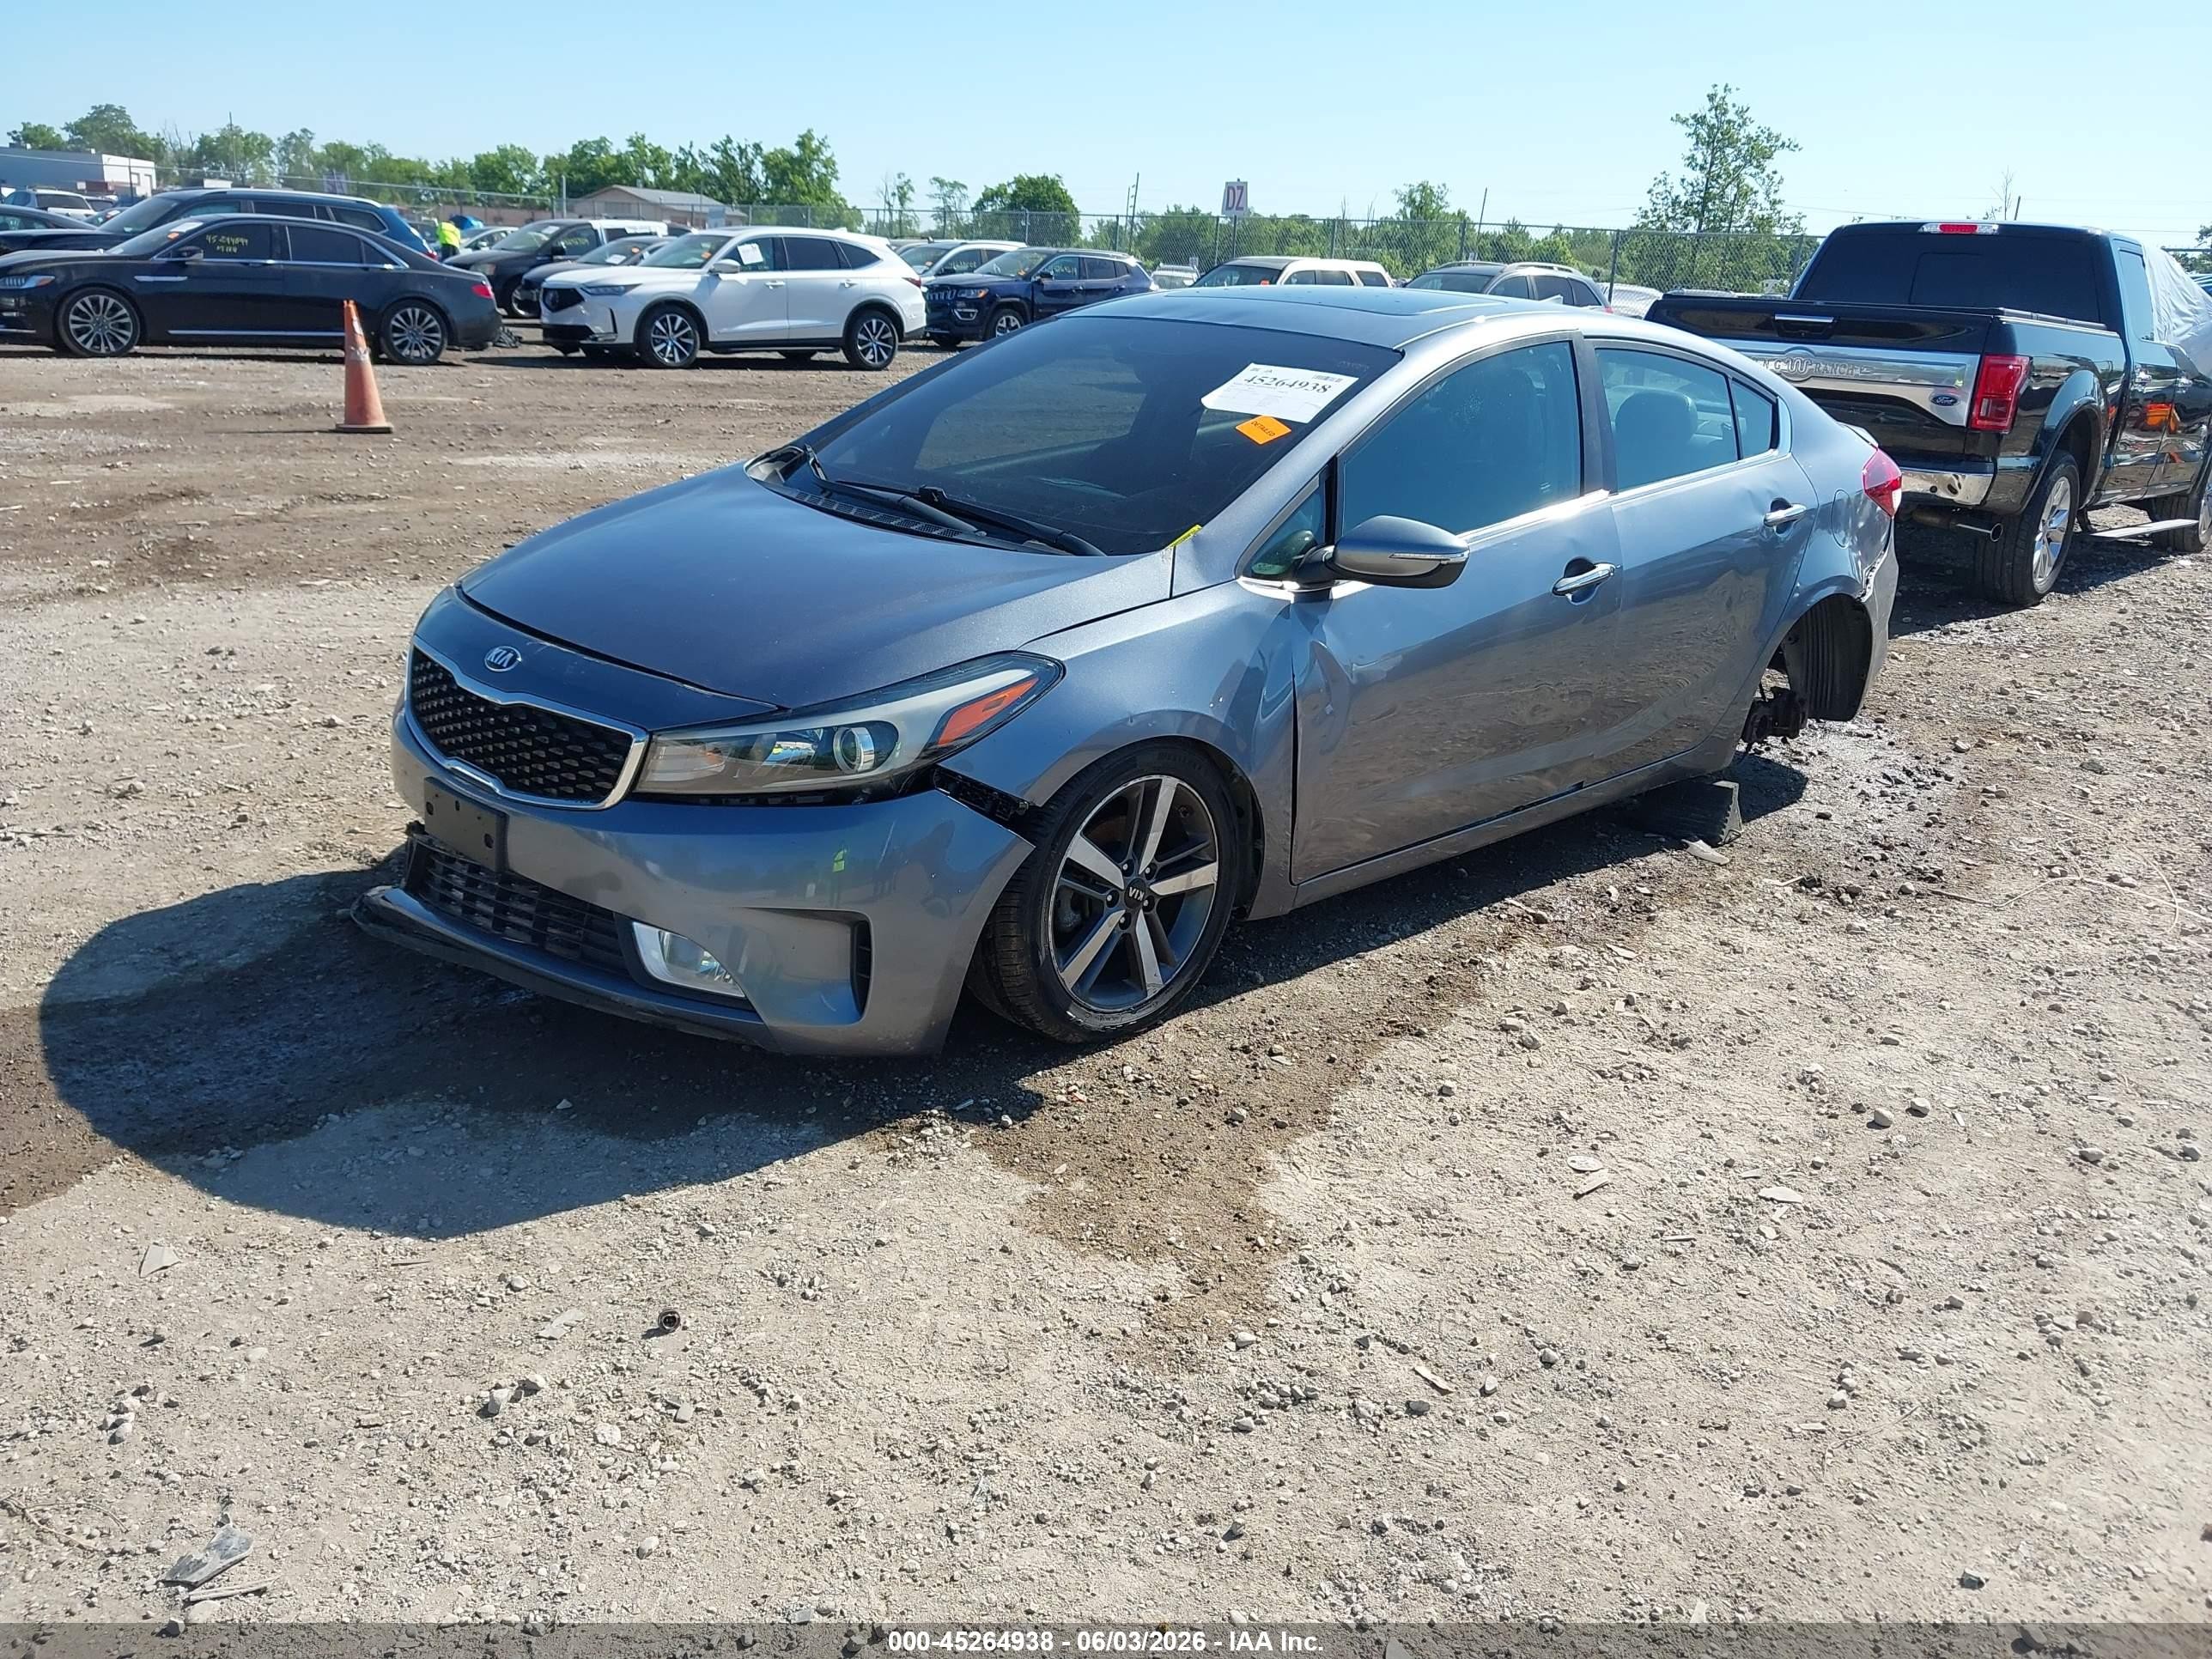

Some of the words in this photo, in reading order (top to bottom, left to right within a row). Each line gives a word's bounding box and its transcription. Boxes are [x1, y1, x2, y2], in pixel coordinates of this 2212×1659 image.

[1225, 185, 1244, 211] DZ
[1814, 362, 1855, 376] RANCH
[1243, 374, 1332, 394] 45264938
[1250, 420, 1276, 437] DETAILED
[487, 648, 514, 668] KIA
[1128, 886, 1145, 902] KIA
